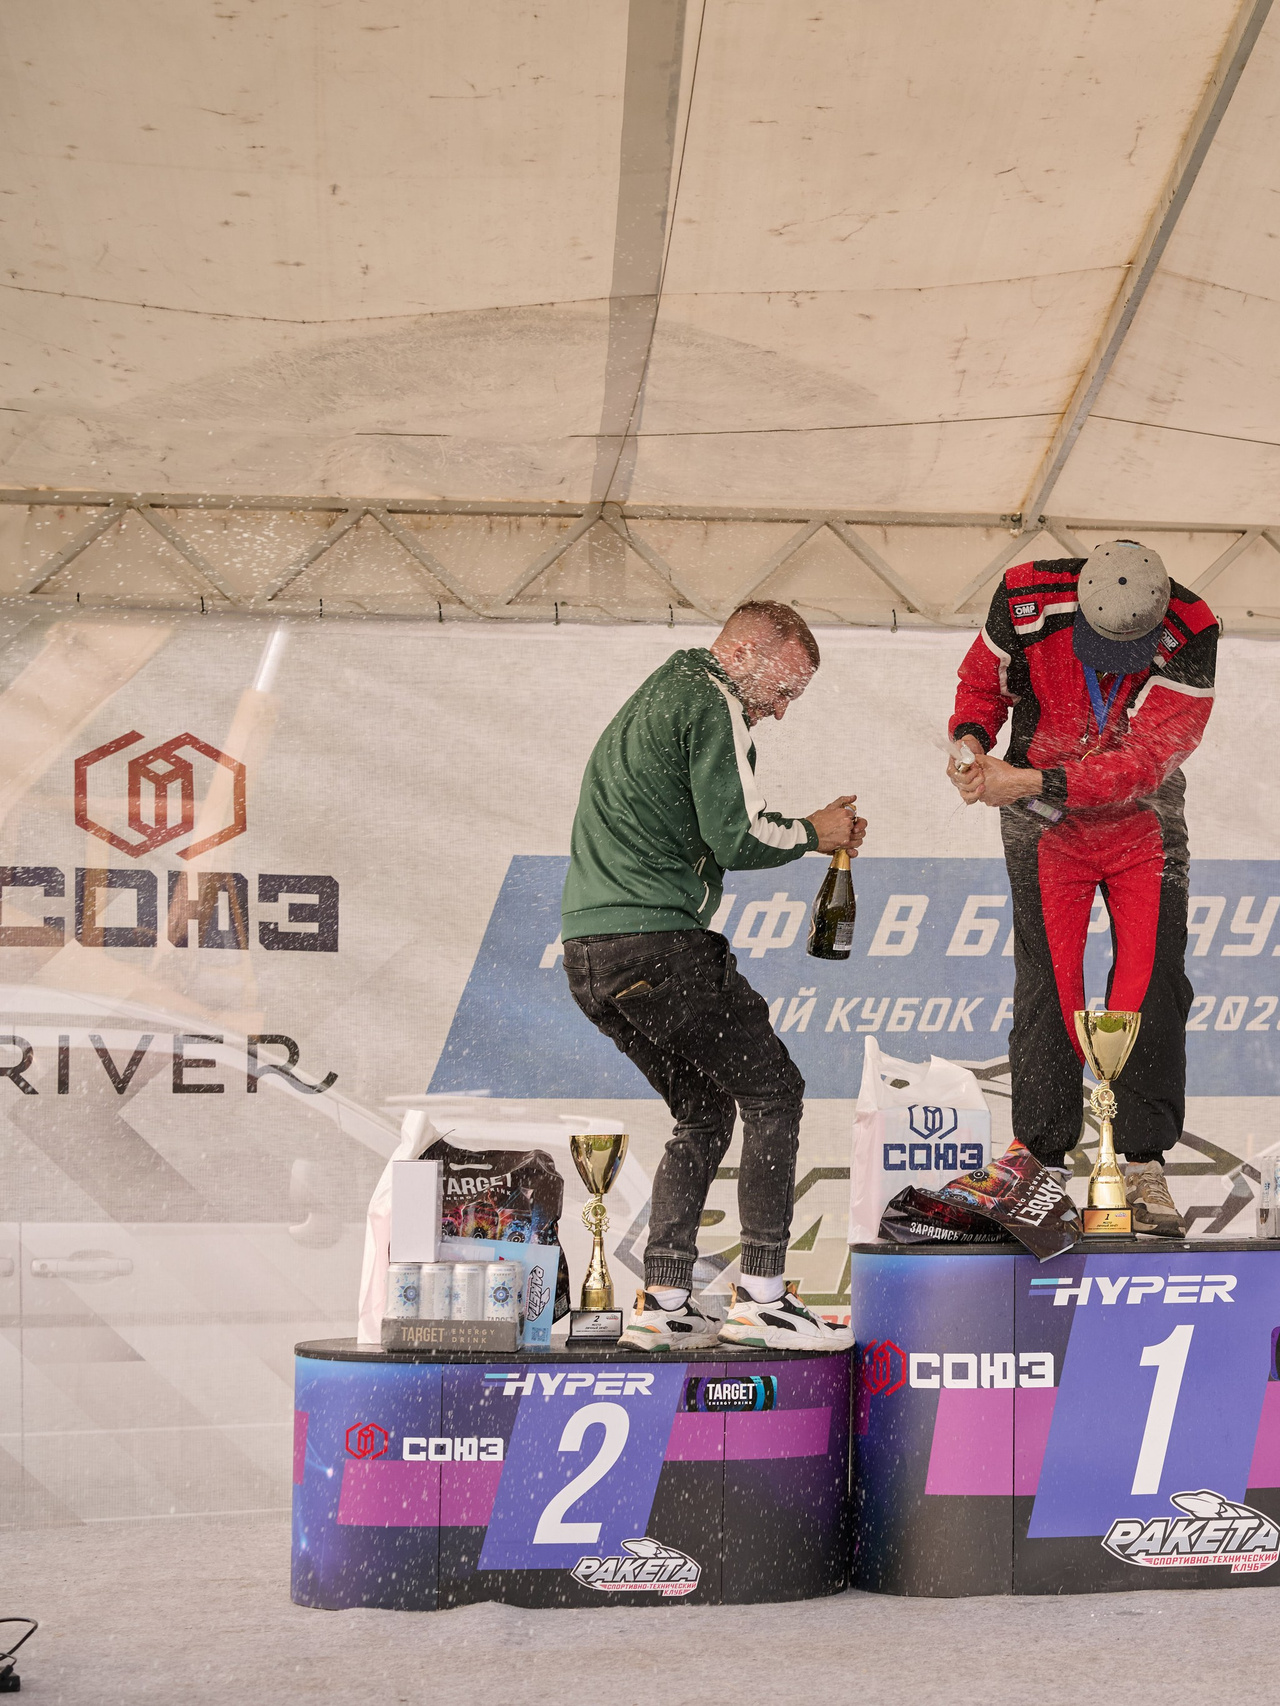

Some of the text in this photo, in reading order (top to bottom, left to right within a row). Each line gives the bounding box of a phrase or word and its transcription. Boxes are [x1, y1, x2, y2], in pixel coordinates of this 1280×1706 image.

[1015, 604, 1036, 616] OMP
[0, 865, 340, 952] СОЮЗ
[867, 895, 930, 957] В
[825, 997, 972, 1032] КУБОК
[883, 1142, 984, 1171] СОЮЗ
[909, 1221, 959, 1242] ЗАРЯДИСЬ
[1053, 1274, 1238, 1306] HYPER
[593, 1315, 600, 1323] 2
[401, 1326, 496, 1343] TARGET ENERGY
[452, 1337, 488, 1345] DRINK
[909, 1352, 1055, 1389] СОЮЗ
[502, 1372, 655, 1396] HYPER
[706, 1383, 755, 1401] TARGET
[1131, 1324, 1195, 1496] 1
[402, 1437, 505, 1462] СОЮЗ
[532, 1401, 631, 1545] 2
[1107, 1518, 1279, 1557] РАКЕТА
[573, 1558, 699, 1582] РАКЕТА
[1153, 1552, 1278, 1566] СПОРТИВНО-ТЕХНИЧЕСКИЙ
[1232, 1562, 1260, 1572] КЛУБ
[606, 1582, 697, 1590] СПОРТИВНО-ТЕХНИЧЕСКИЙ
